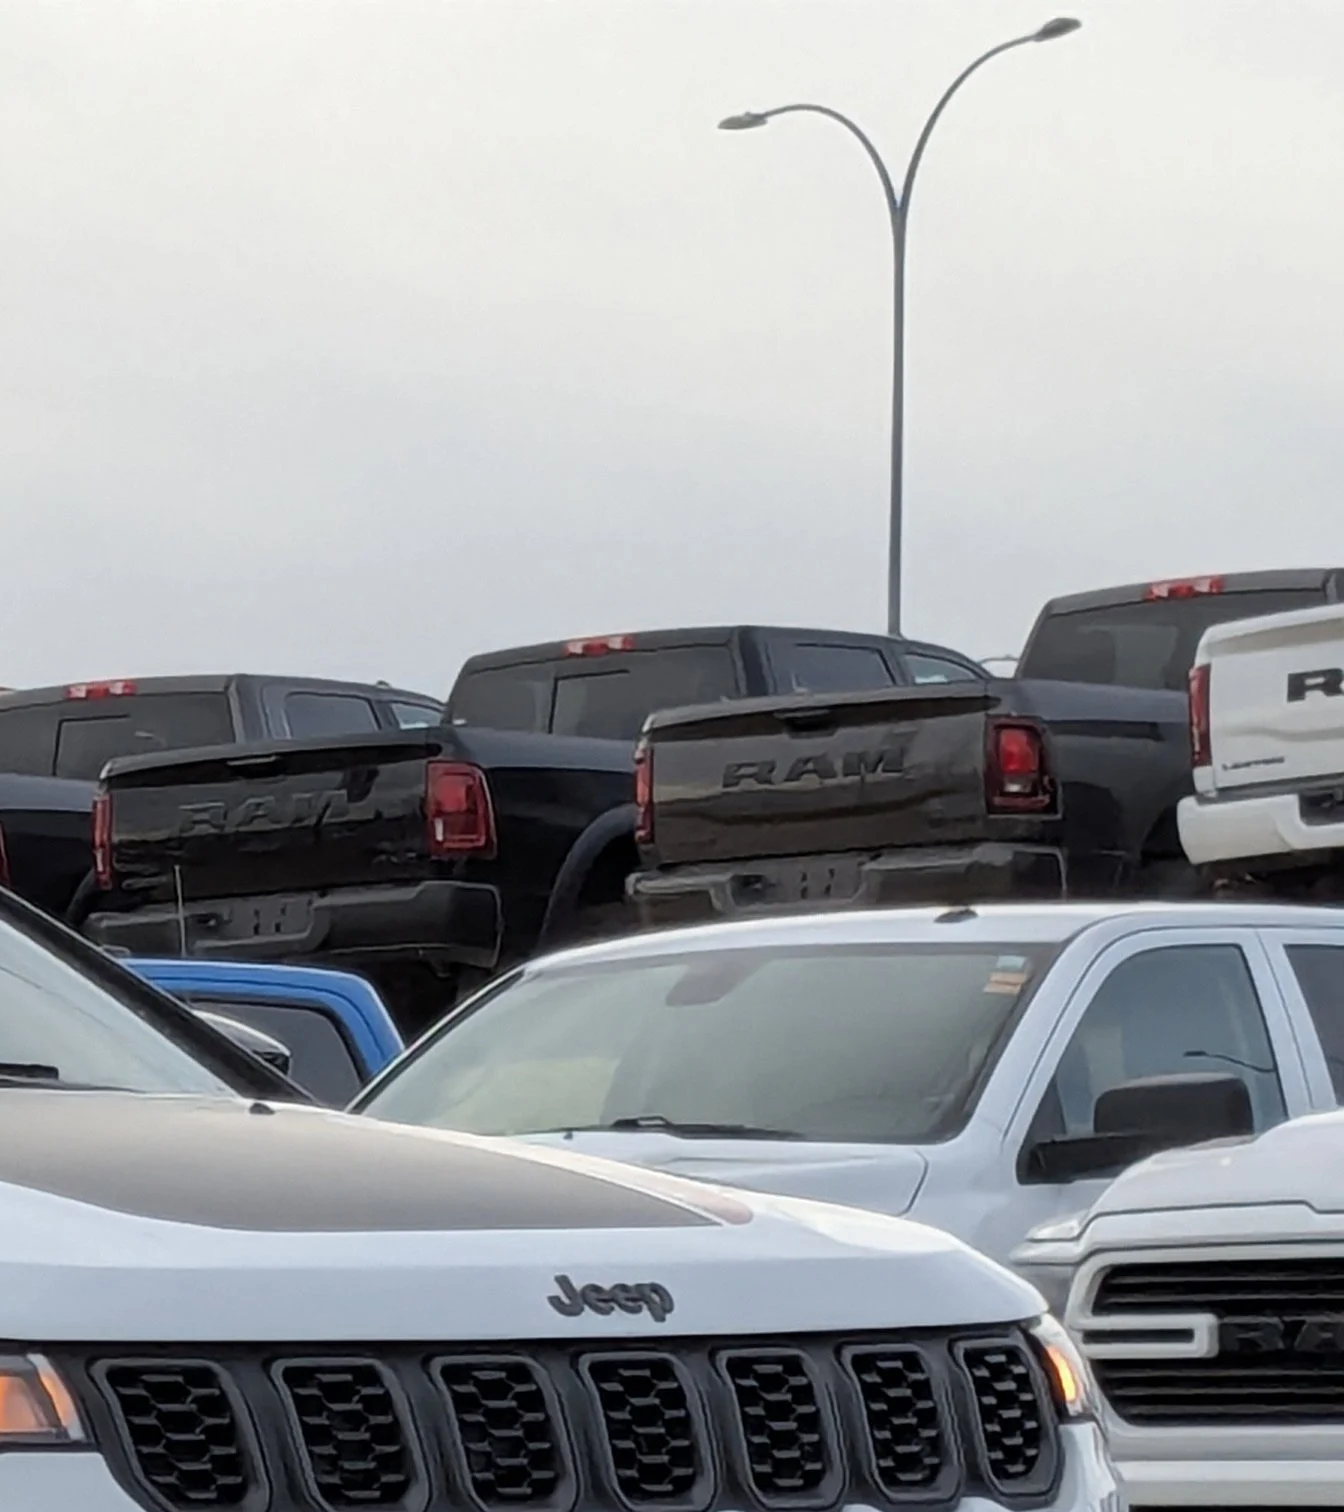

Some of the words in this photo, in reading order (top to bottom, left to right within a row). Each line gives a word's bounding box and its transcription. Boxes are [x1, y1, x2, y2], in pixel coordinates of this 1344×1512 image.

[721, 748, 904, 789] RAM
[177, 788, 349, 836] RAM
[547, 1274, 675, 1323] Jeep
